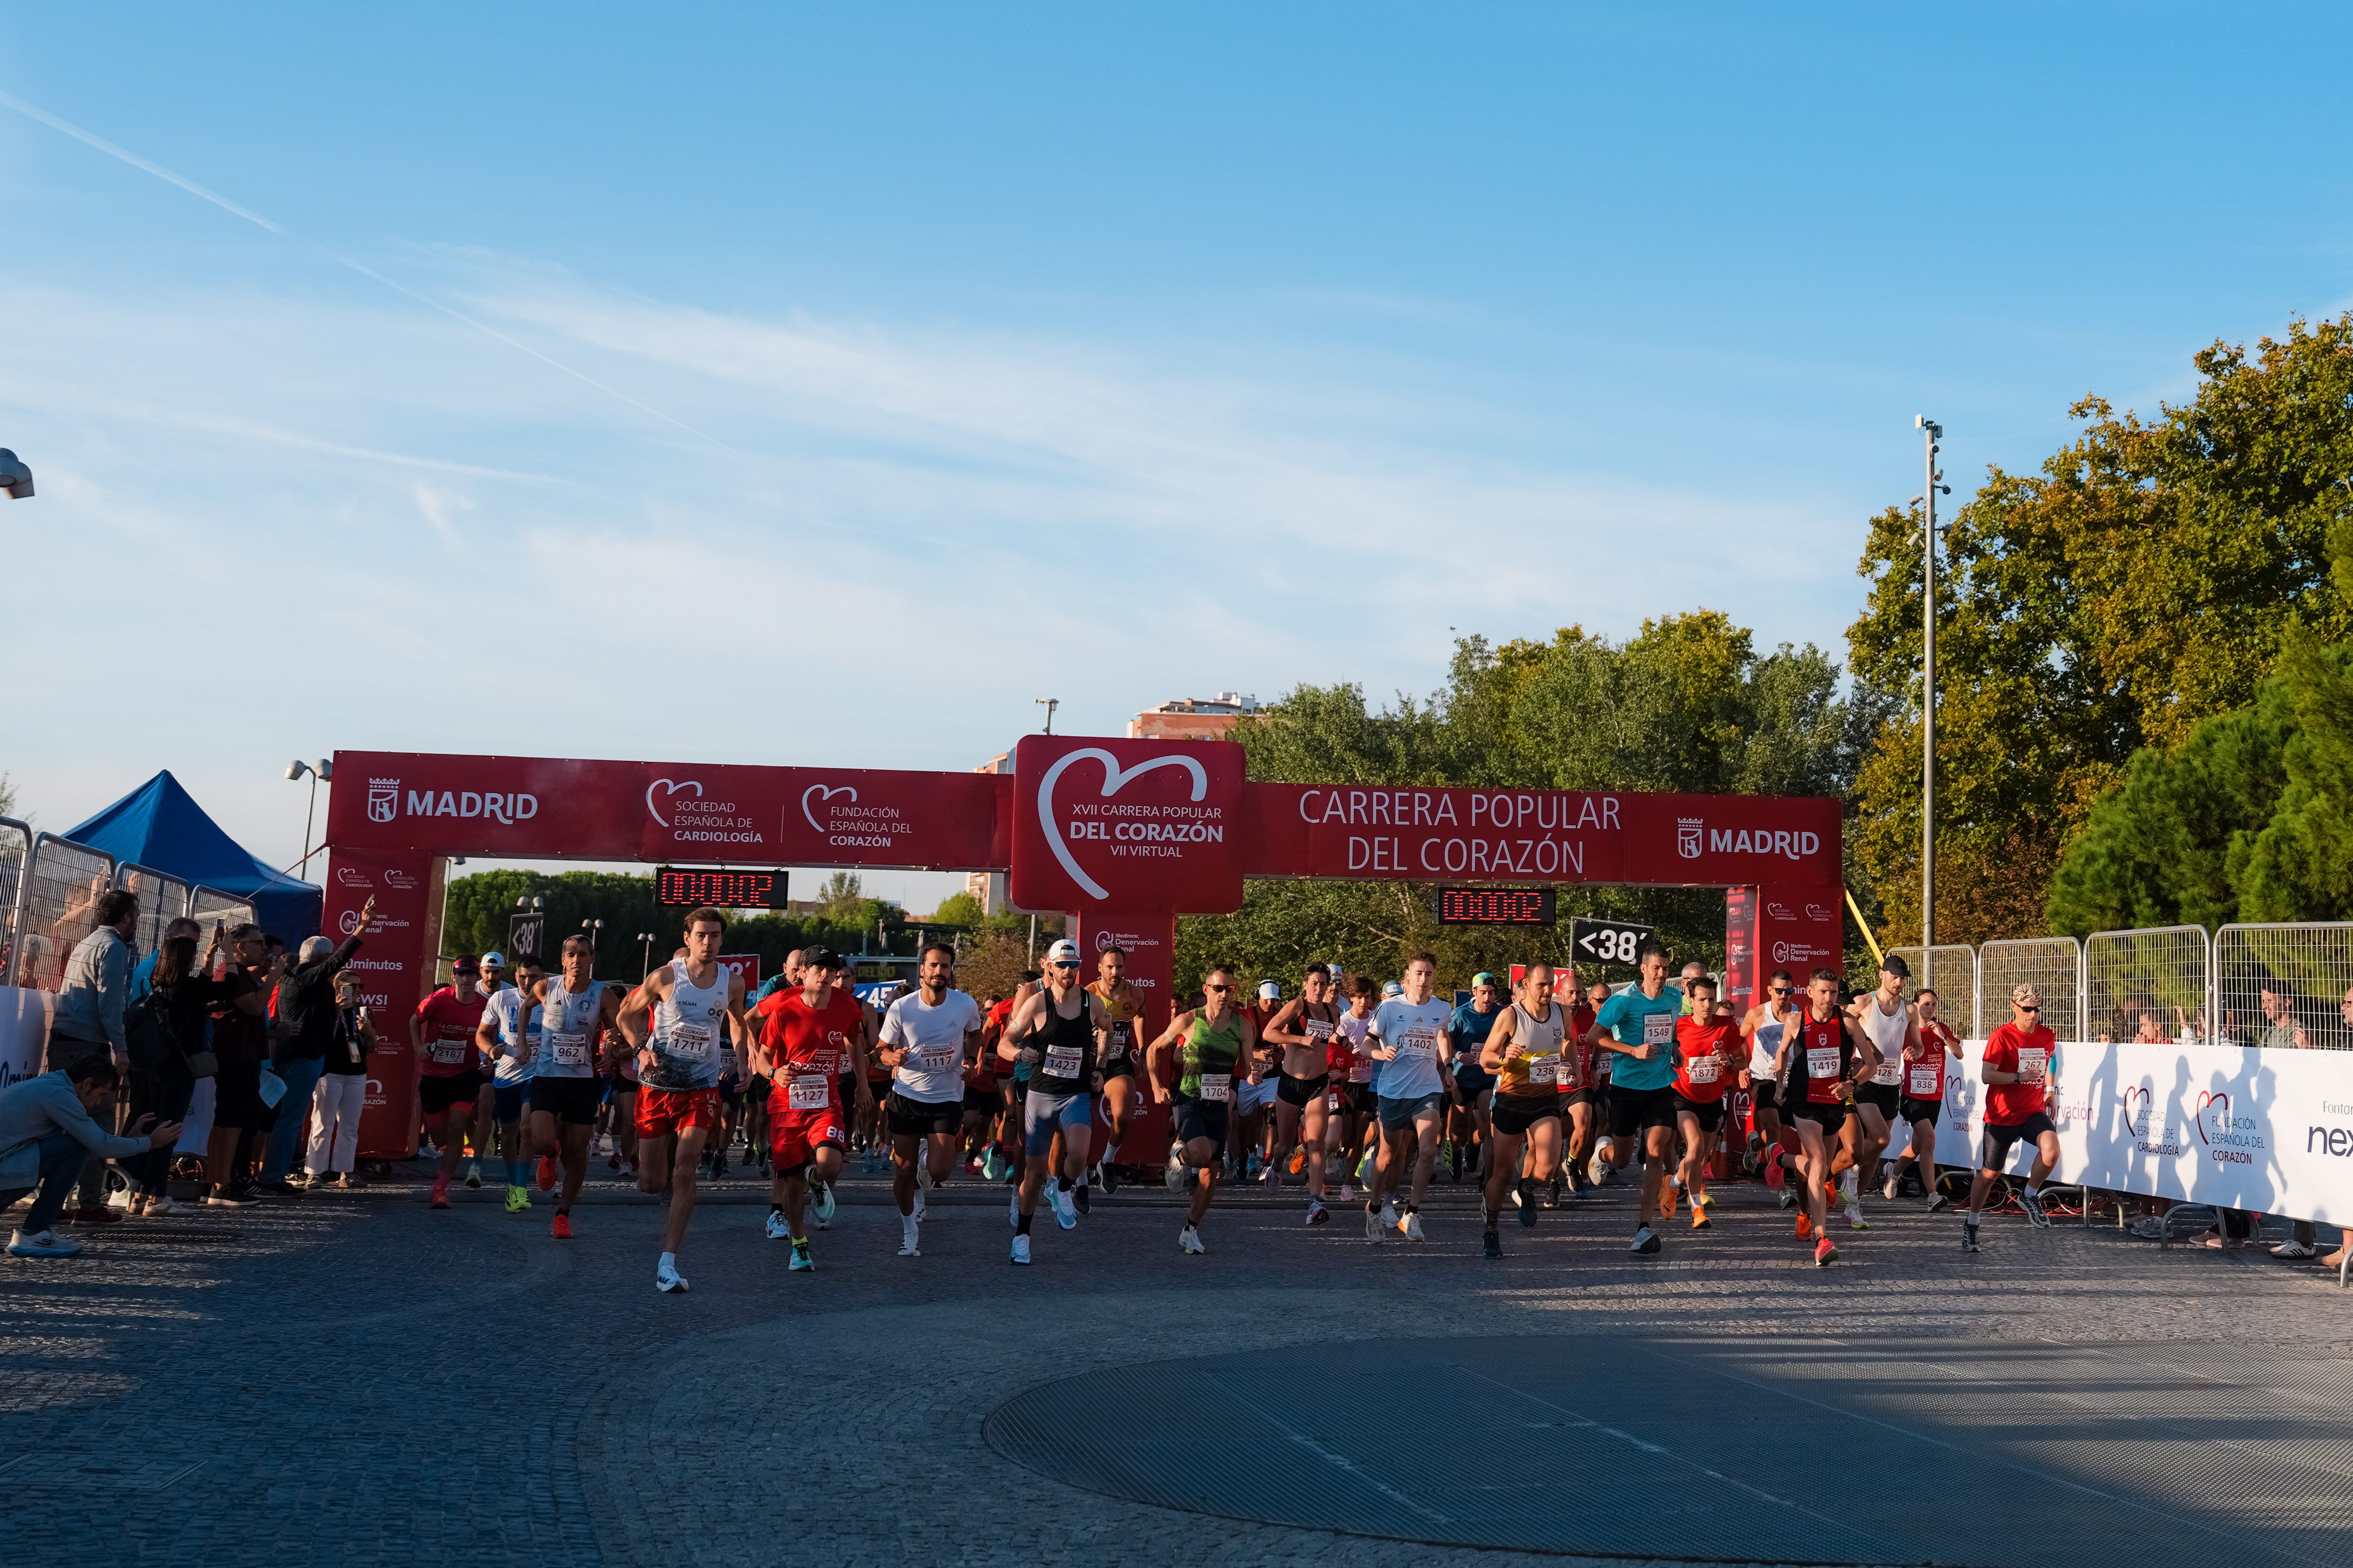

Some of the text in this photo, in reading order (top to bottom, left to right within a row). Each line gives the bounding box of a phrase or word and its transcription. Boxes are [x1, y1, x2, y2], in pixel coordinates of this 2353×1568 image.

[406, 789, 538, 825] MADRID
[675, 800, 736, 813] SOCIEDAD
[830, 805, 900, 819] FUNDACIÓN
[1072, 804, 1222, 819] XVII CARRERA POPULAR
[1299, 790, 1621, 830] CARRERA POPULAR
[674, 814, 753, 829] ESPAÑOLA DE
[830, 819, 912, 834] ESPAÑOLA DEL
[673, 829, 763, 843] CARDIOLOGÍA
[1070, 820, 1223, 843] DEL CORAZÓN
[829, 834, 892, 848] CORAZÓN
[1710, 829, 1819, 860] MADRID
[1110, 845, 1183, 858] VII VIRTUAL
[1348, 832, 1583, 874] DEL CORAZÓN
[342, 959, 403, 970] 0minutos
[672, 1032, 693, 1040] CARRERA
[685, 1028, 708, 1036] CORAZÓN
[1309, 1029, 1331, 1039] 2263
[1648, 1028, 1669, 1037] 1549
[674, 1038, 703, 1052] 1711
[1408, 1039, 1432, 1049] 1402
[438, 1049, 462, 1058] 2187
[558, 1047, 579, 1057] 962
[925, 1055, 952, 1067] 1117
[1049, 1059, 1077, 1070] 1423
[1812, 1060, 1838, 1071] 1419
[2024, 1061, 2041, 1070] 267
[1536, 1067, 1555, 1077] 238
[1693, 1068, 1715, 1078] 1872
[1916, 1080, 1932, 1089] 838
[794, 1090, 824, 1101] 1127
[1205, 1088, 1227, 1096] 1704
[2137, 1109, 2165, 1122] SOCIEDAD
[2212, 1116, 2256, 1130] FUNDACIÓN
[826, 1126, 845, 1143] 88
[2137, 1124, 2174, 1139] ESPAÑOLA DE
[2212, 1132, 2266, 1148] ESPAÑOLA DEL
[2138, 1141, 2179, 1156] CARDIOLOGÍA
[2212, 1149, 2252, 1165] CORAZÓN
